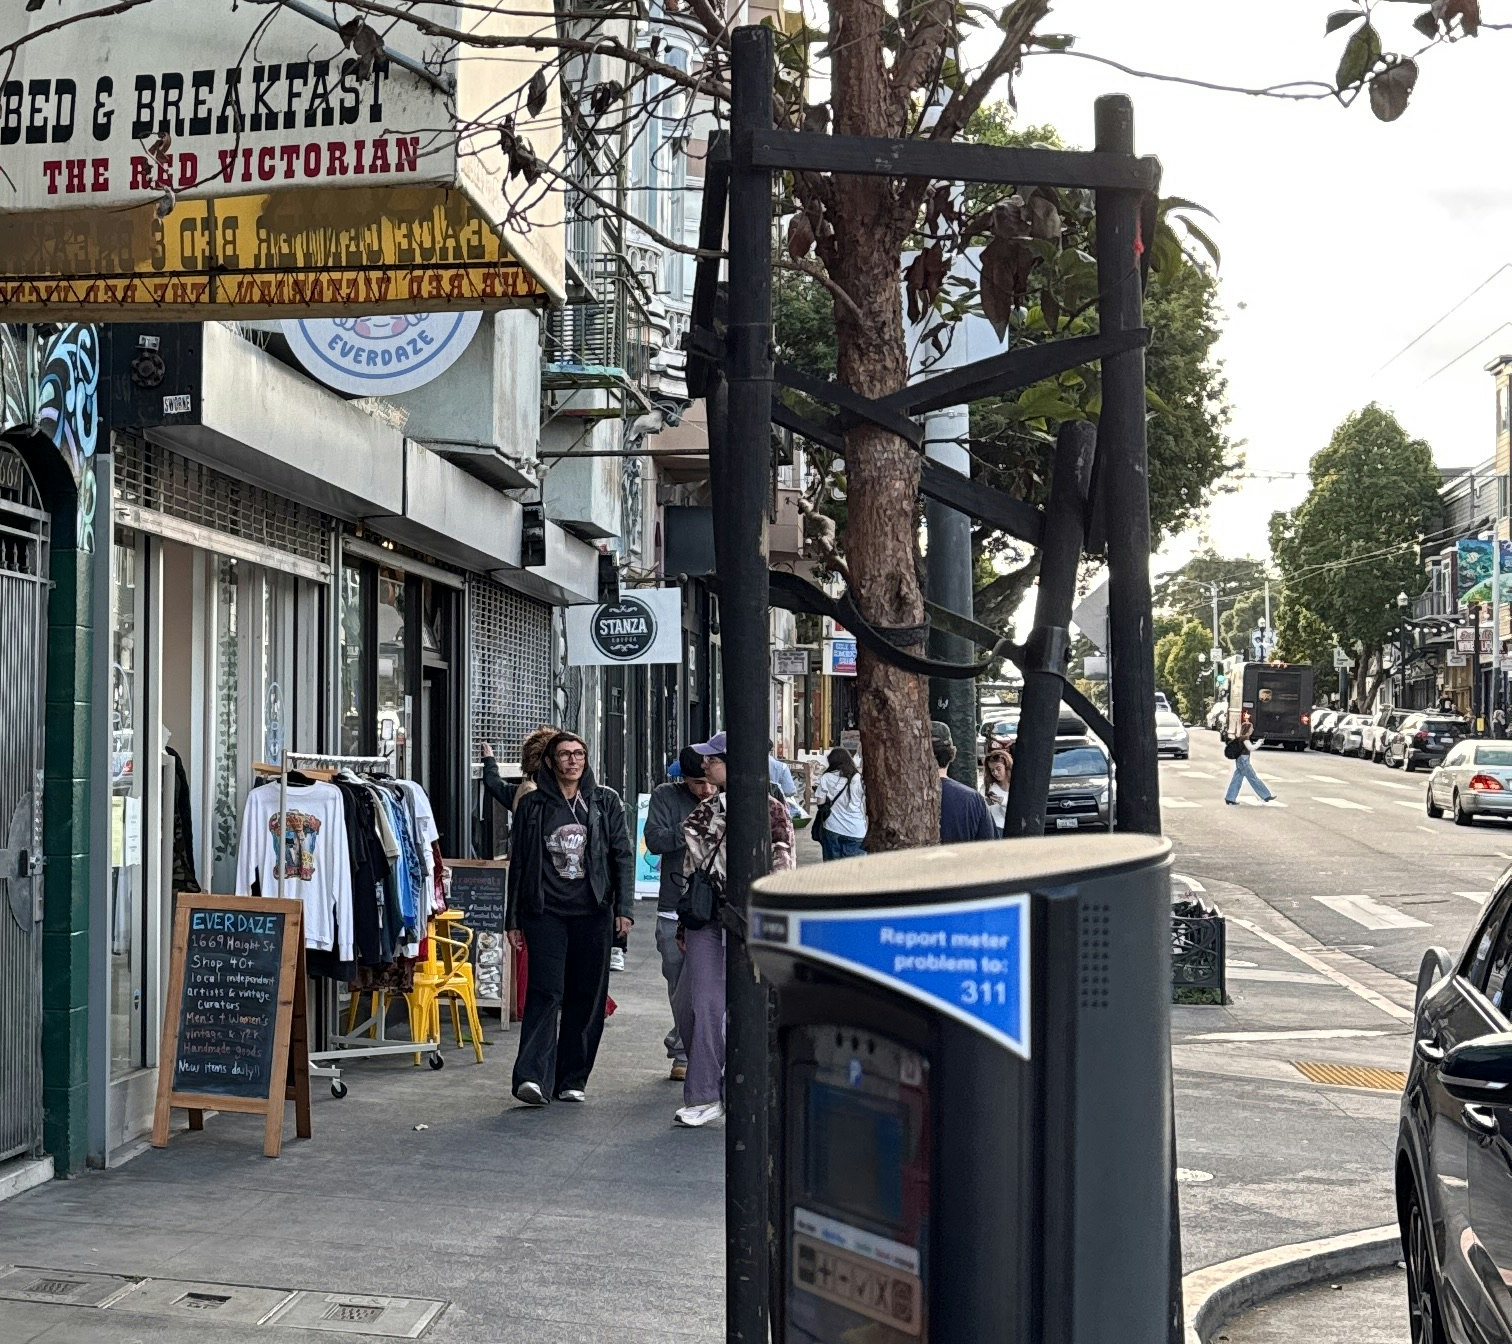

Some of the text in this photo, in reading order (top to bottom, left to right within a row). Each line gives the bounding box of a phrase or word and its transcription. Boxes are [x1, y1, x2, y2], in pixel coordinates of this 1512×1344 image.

[0, 76, 77, 146] BED
[92, 75, 115, 142] &
[131, 57, 389, 140] BREAKFAST
[43, 158, 110, 195] THE
[129, 152, 198, 191] RED
[218, 137, 420, 183] VICTORIAN
[327, 329, 435, 367] EVERDAZE
[599, 617, 649, 635] STANZA
[192, 912, 277, 935] EVERDAZE
[191, 934, 276, 955] 1669 Haight St
[879, 927, 1010, 949] Report meter
[191, 954, 255, 973] Shop 40+
[893, 953, 1008, 974] problem to:
[191, 971, 222, 984] local
[187, 985, 271, 1003] artists & vintage
[960, 979, 1007, 1005] 311
[186, 1011, 214, 1025] Men's
[228, 1013, 269, 1027] Women's
[185, 1027, 224, 1043] vintage
[228, 1028, 236, 1040] &
[183, 1038, 263, 1061] Handmade goods
[178, 1058, 200, 1074] New
[204, 1059, 228, 1075] items
